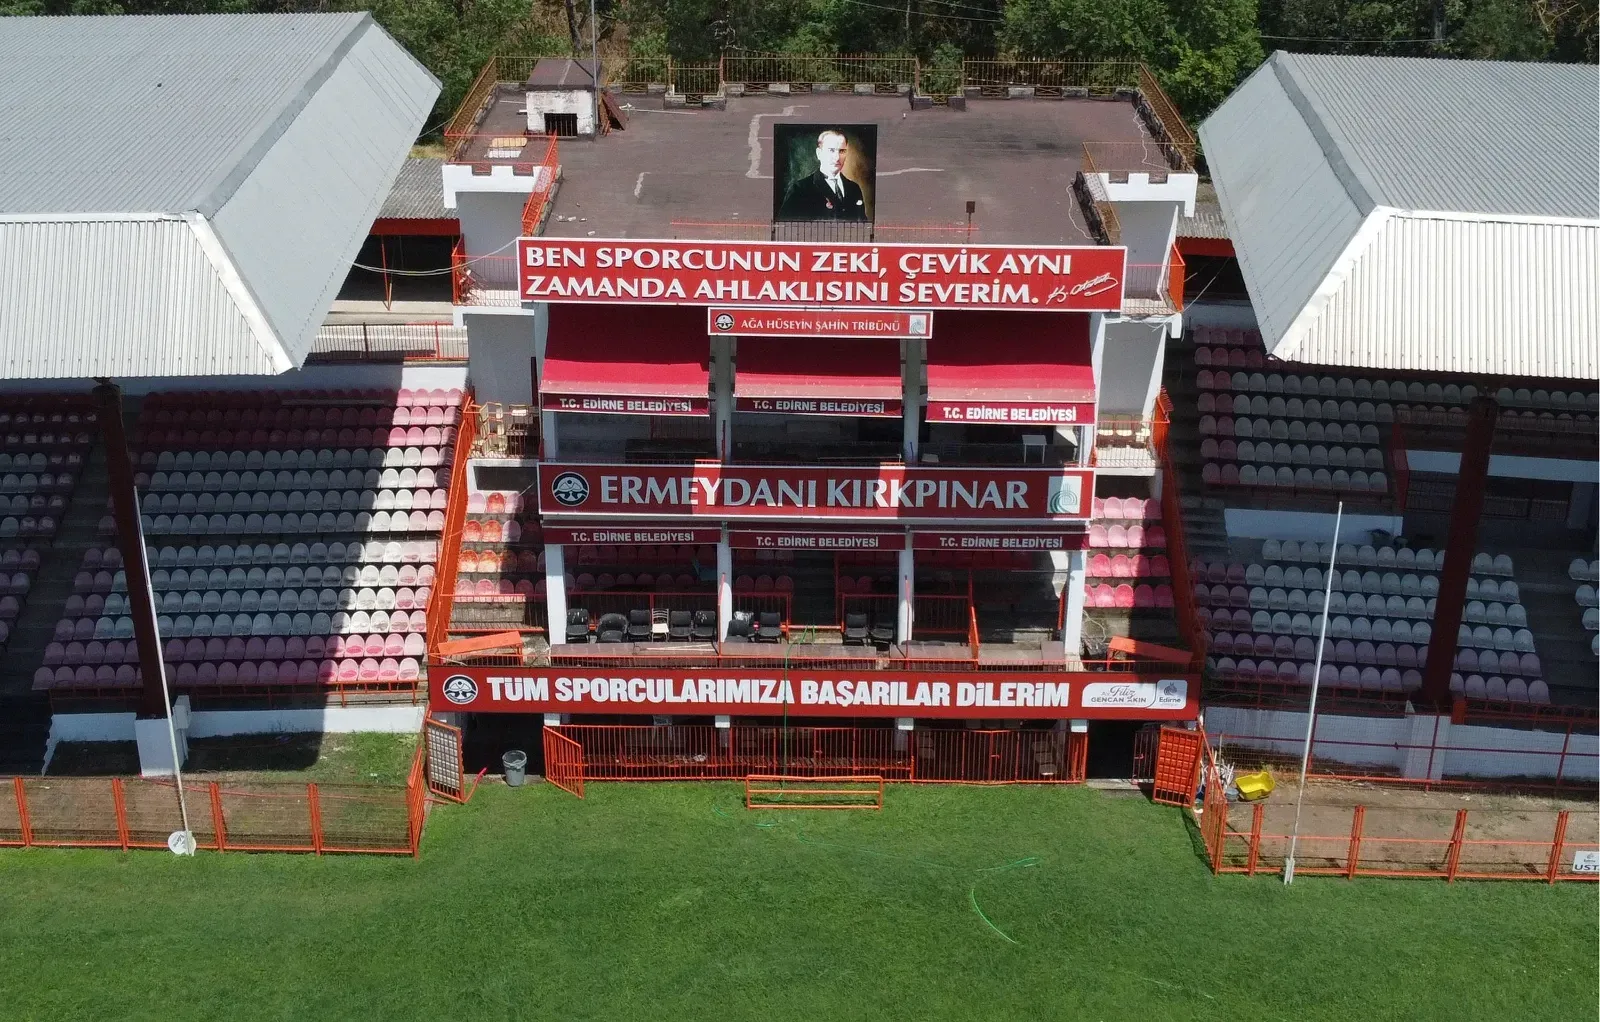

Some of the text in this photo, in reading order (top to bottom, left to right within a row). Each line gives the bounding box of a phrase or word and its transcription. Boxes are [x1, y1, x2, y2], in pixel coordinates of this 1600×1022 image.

[526, 246, 1073, 279] BEN SPORCUNUN ZEKİ, ÇEVİK AYNI
[525, 275, 1039, 304] ZAMANDA AHLAKLISINI SEVERİM.
[741, 317, 900, 333] AĞA HÜSEYİN ŞAHİN TRİBÜNÜ
[560, 398, 692, 412] T.C. EDİRNE BELEDİYESİ
[753, 400, 885, 414] T.C. EDİRNE BELEDİYESİ
[943, 405, 1077, 422] T.C. EDİRNE BELEDİYESİ
[601, 475, 1029, 509] ERMEYDANI KIRKPINAR
[571, 530, 695, 542] T.C. EDİRNE BELEDİYESİ
[756, 535, 879, 548] T.C. EDİRNE BELEDİYESİ
[940, 536, 1063, 549] T.C. EDİRNE BELEDİYESİ
[486, 676, 1070, 707] TÜM SPORCULARIMIZA BAŞARILAR DİLERİM
[1109, 685, 1136, 700] Filiz
